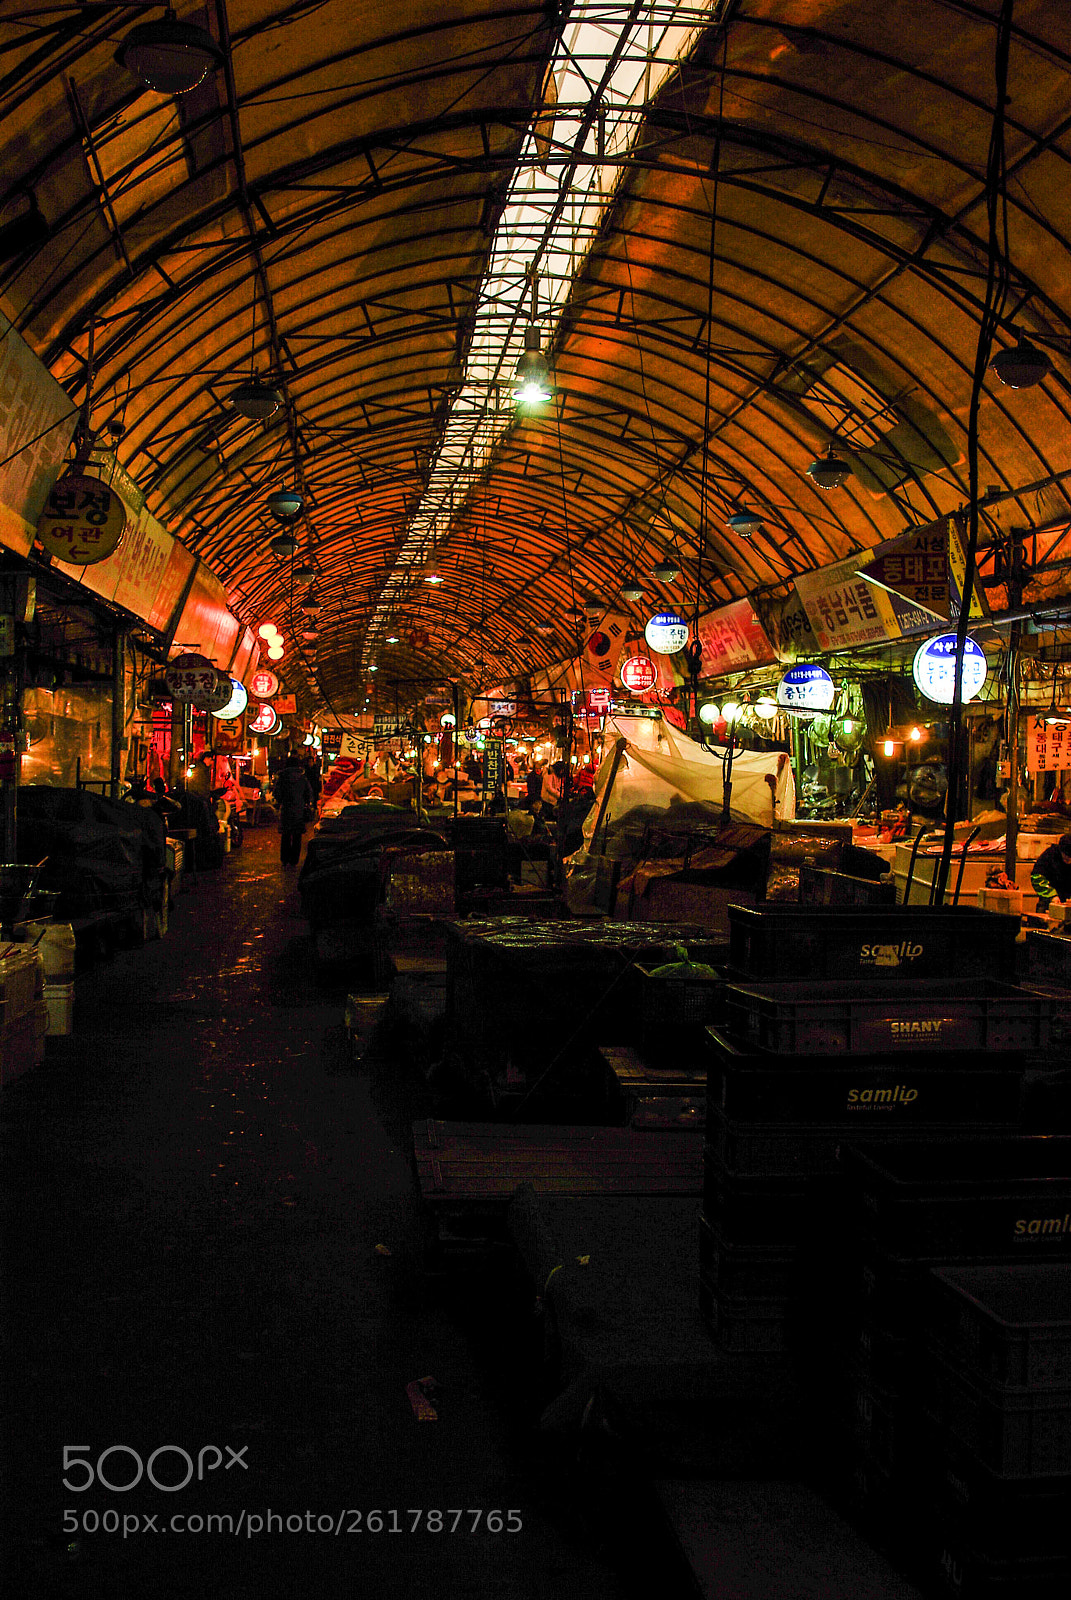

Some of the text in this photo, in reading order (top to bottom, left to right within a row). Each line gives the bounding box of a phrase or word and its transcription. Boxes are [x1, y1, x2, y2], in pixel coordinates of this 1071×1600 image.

[51, 526, 104, 543] 여관
[882, 556, 945, 583] 동태포
[914, 586, 946, 601] 전문
[816, 581, 877, 632] 충남식품
[934, 641, 974, 652] 사성산
[847, 1085, 918, 1106] samlip
